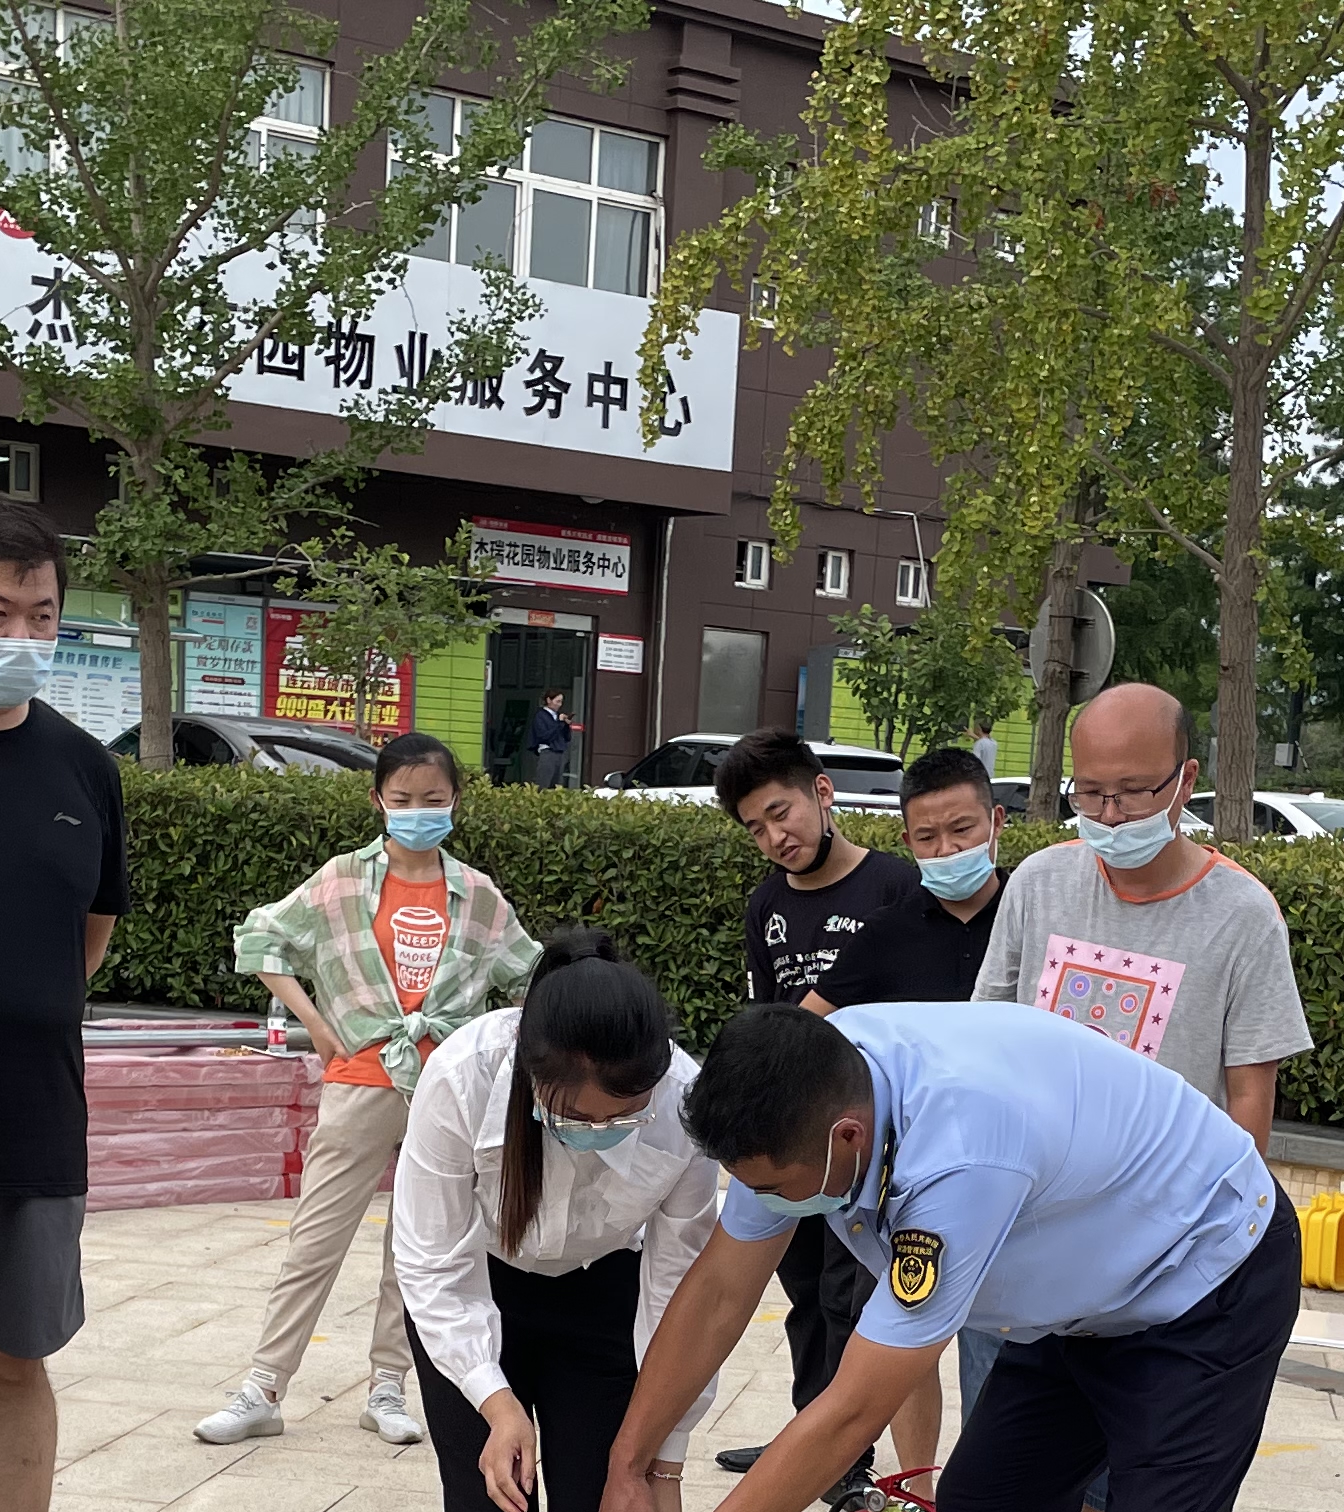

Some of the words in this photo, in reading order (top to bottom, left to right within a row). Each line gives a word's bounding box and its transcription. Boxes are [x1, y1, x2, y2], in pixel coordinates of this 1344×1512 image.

[27, 266, 692, 438] 杰园物业服务中心
[473, 537, 626, 579] 杰瑞花园物业服务中心
[398, 932, 440, 948] NEED
[398, 950, 433, 963] MORE
[399, 964, 432, 989] COFFEE
